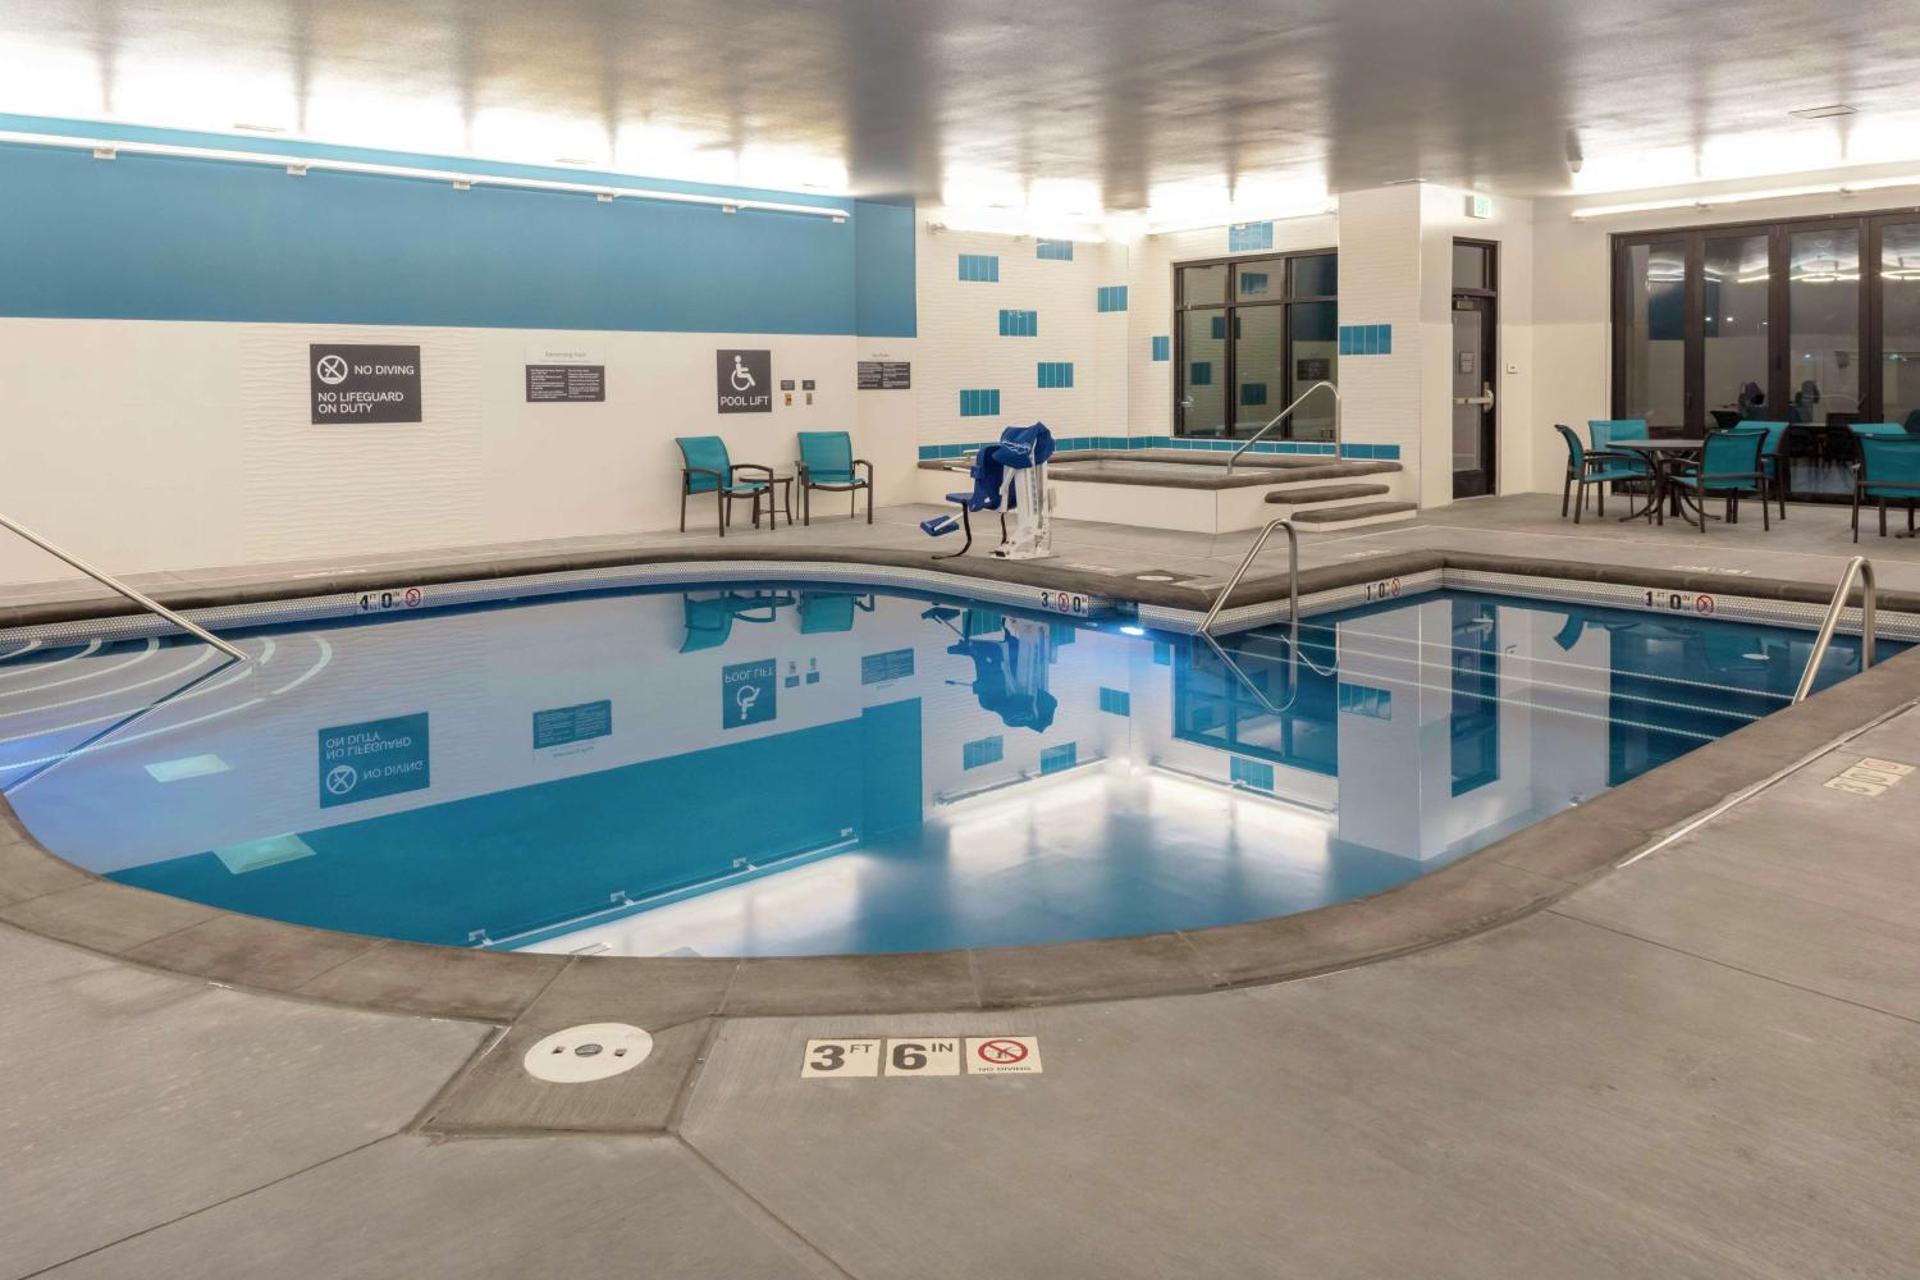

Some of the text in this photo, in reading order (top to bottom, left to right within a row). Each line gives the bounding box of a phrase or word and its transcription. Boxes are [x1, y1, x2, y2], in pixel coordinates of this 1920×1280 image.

[354, 365, 415, 375] NO DIVING
[318, 392, 404, 402] NO LIFEGUARD
[720, 395, 770, 406] POOL LIFT
[318, 403, 373, 414] ON DUTY
[810, 1042, 954, 1071] 3 FT 6 IN
